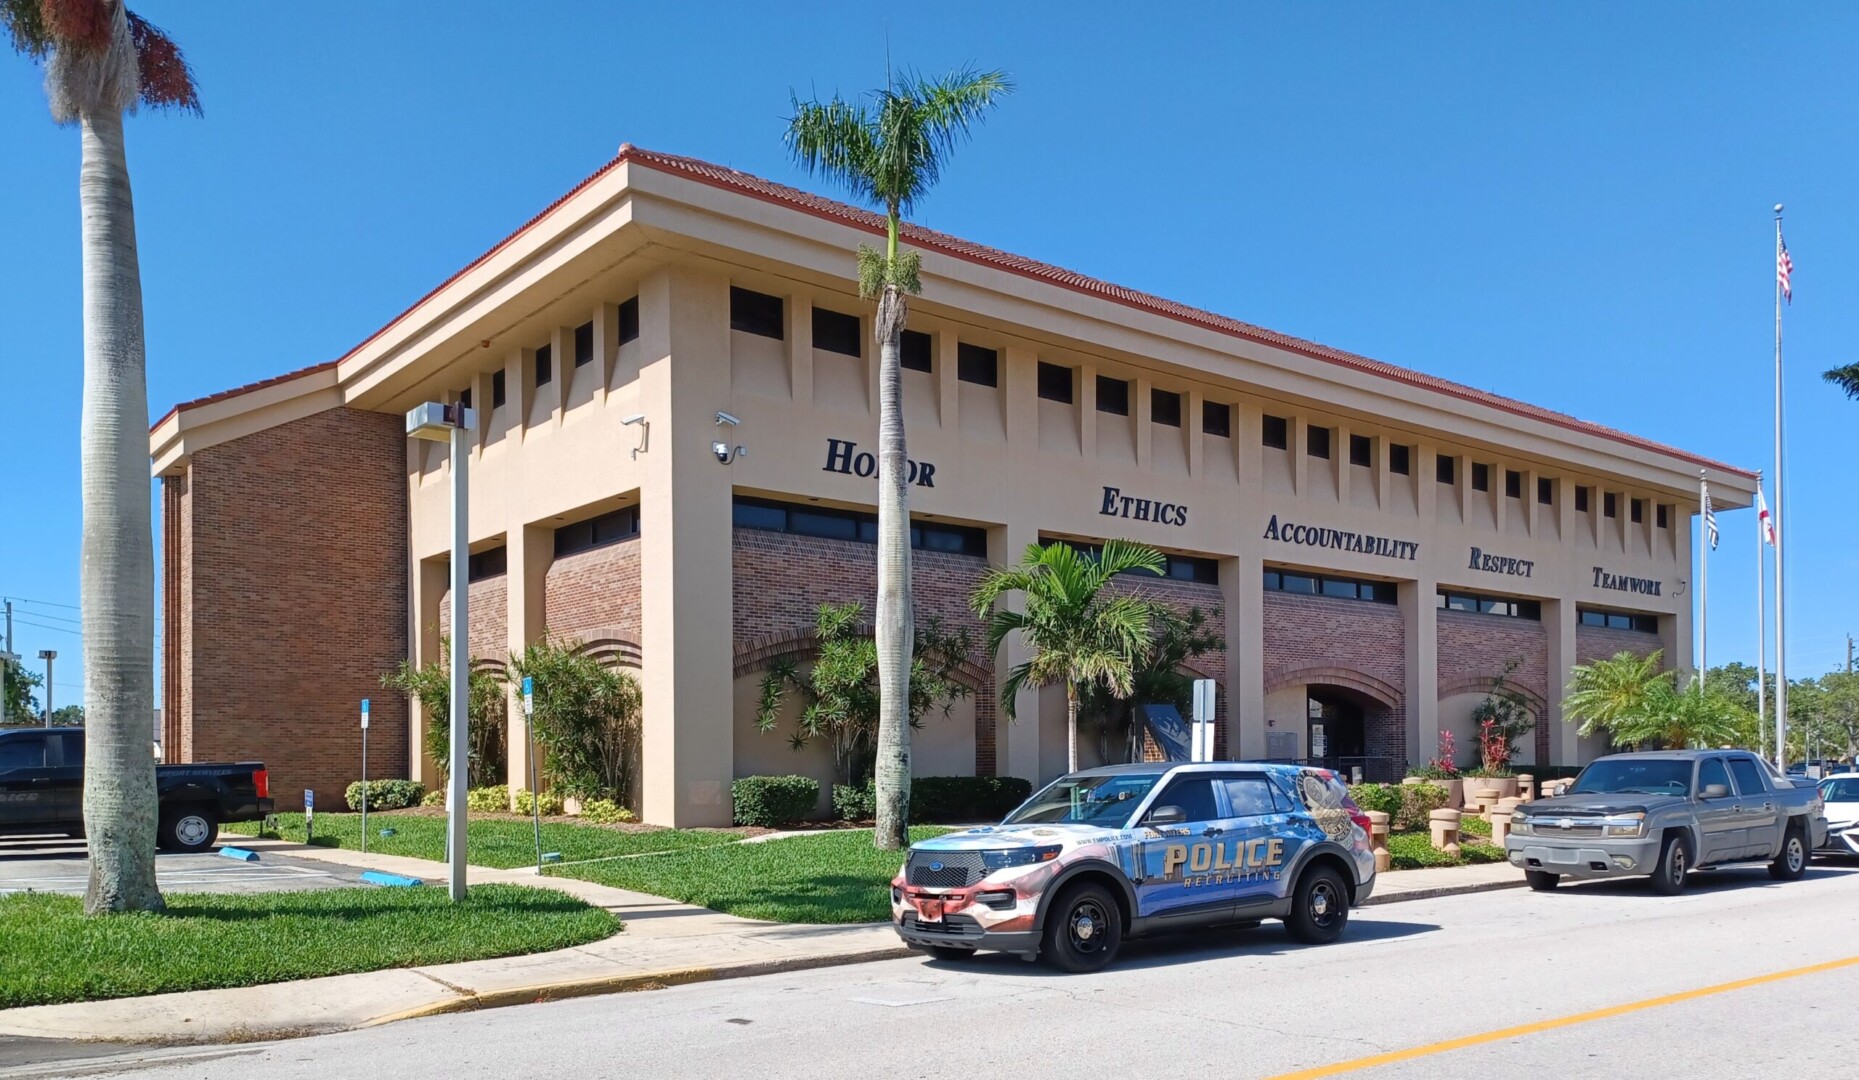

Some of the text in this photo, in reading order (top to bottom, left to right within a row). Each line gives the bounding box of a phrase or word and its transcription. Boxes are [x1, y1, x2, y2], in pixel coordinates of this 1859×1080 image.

[822, 438, 936, 488] HOOR
[1100, 486, 1188, 527] ETHICS
[1262, 514, 1419, 561] ACCOUNTABILITY
[1468, 546, 1534, 578] RESPECT
[1592, 566, 1662, 597] TEAMWORK
[1164, 838, 1284, 874] POLICE
[1184, 872, 1281, 888] RECRUITING
